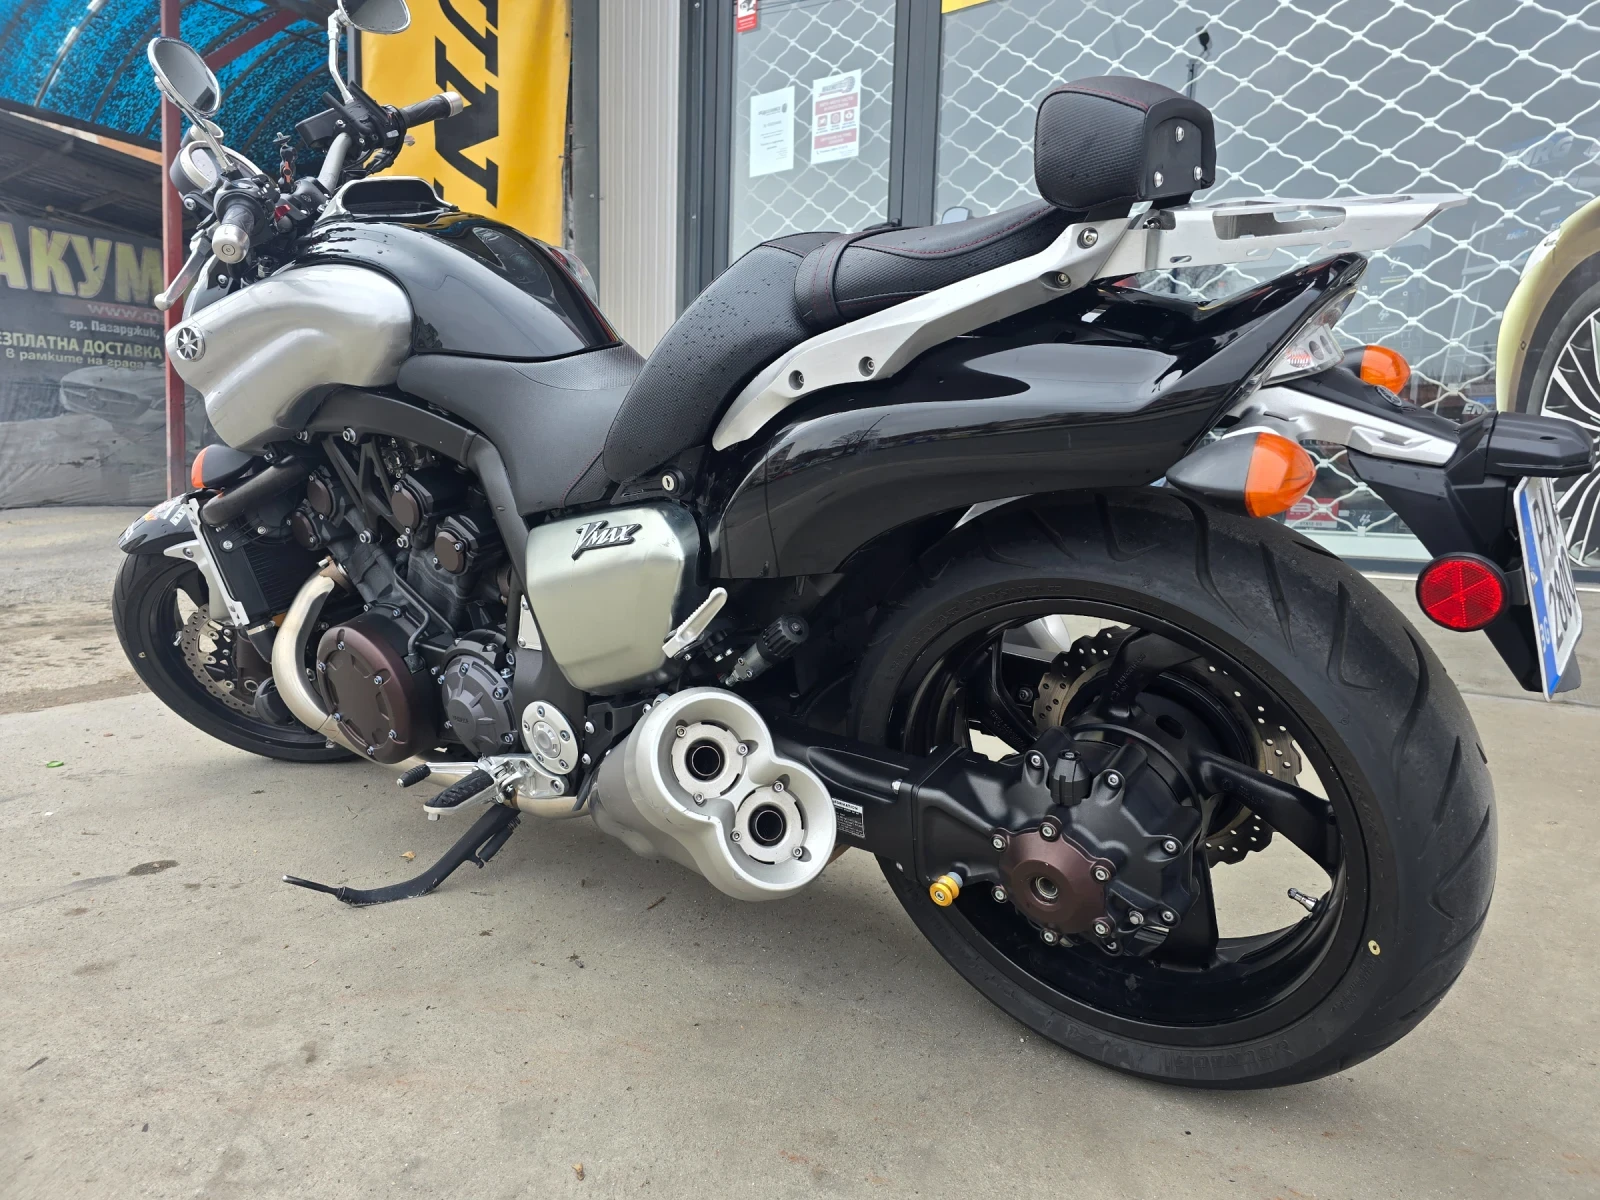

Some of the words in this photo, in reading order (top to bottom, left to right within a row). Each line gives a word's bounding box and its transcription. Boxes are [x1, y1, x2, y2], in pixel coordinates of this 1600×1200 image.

[433, 0, 499, 209] UN
[86, 303, 163, 322] www.m
[69, 320, 88, 332] гр.
[0, 331, 80, 352] ЗПЛАТНА
[82, 339, 163, 361] ДОСТАВКА
[19, 351, 84, 365] рамките
[87, 356, 103, 366] на
[1461, 402, 1488, 415] EN
